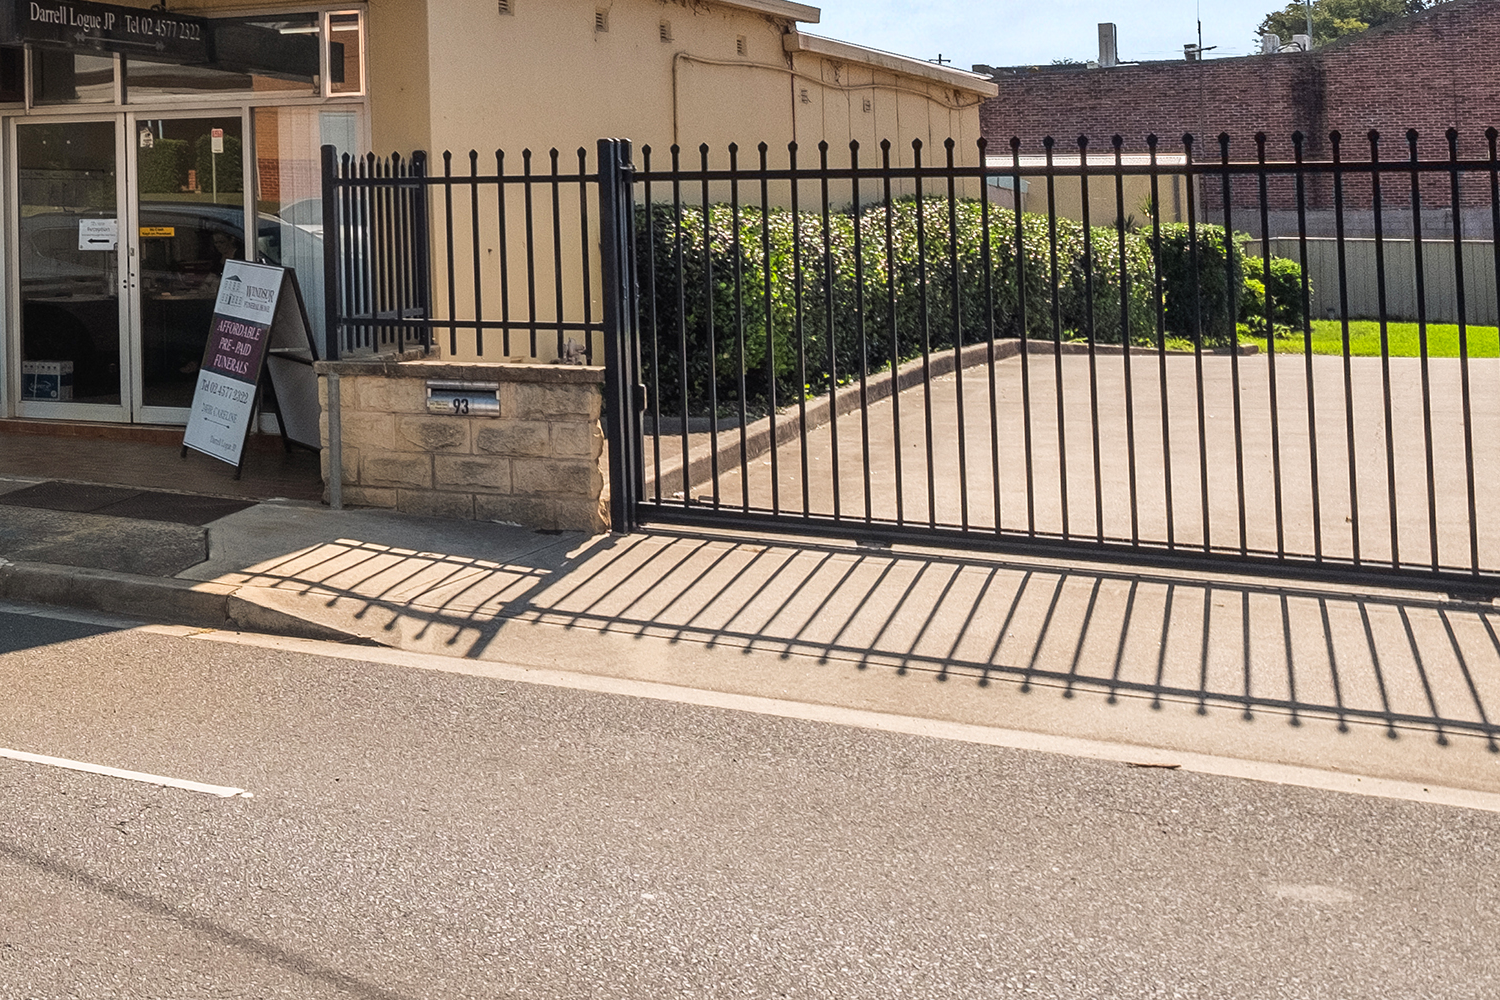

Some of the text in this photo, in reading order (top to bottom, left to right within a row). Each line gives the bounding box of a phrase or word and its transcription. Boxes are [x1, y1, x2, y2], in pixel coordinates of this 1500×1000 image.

[30, 1, 201, 41] Darrell Logue JP Tel 02 4577 2322
[246, 285, 275, 304] WINDSOR
[217, 320, 262, 341] AFFORDABLE
[213, 354, 249, 375] FUNERALS
[218, 385, 233, 399] 4577
[453, 398, 469, 414] 93
